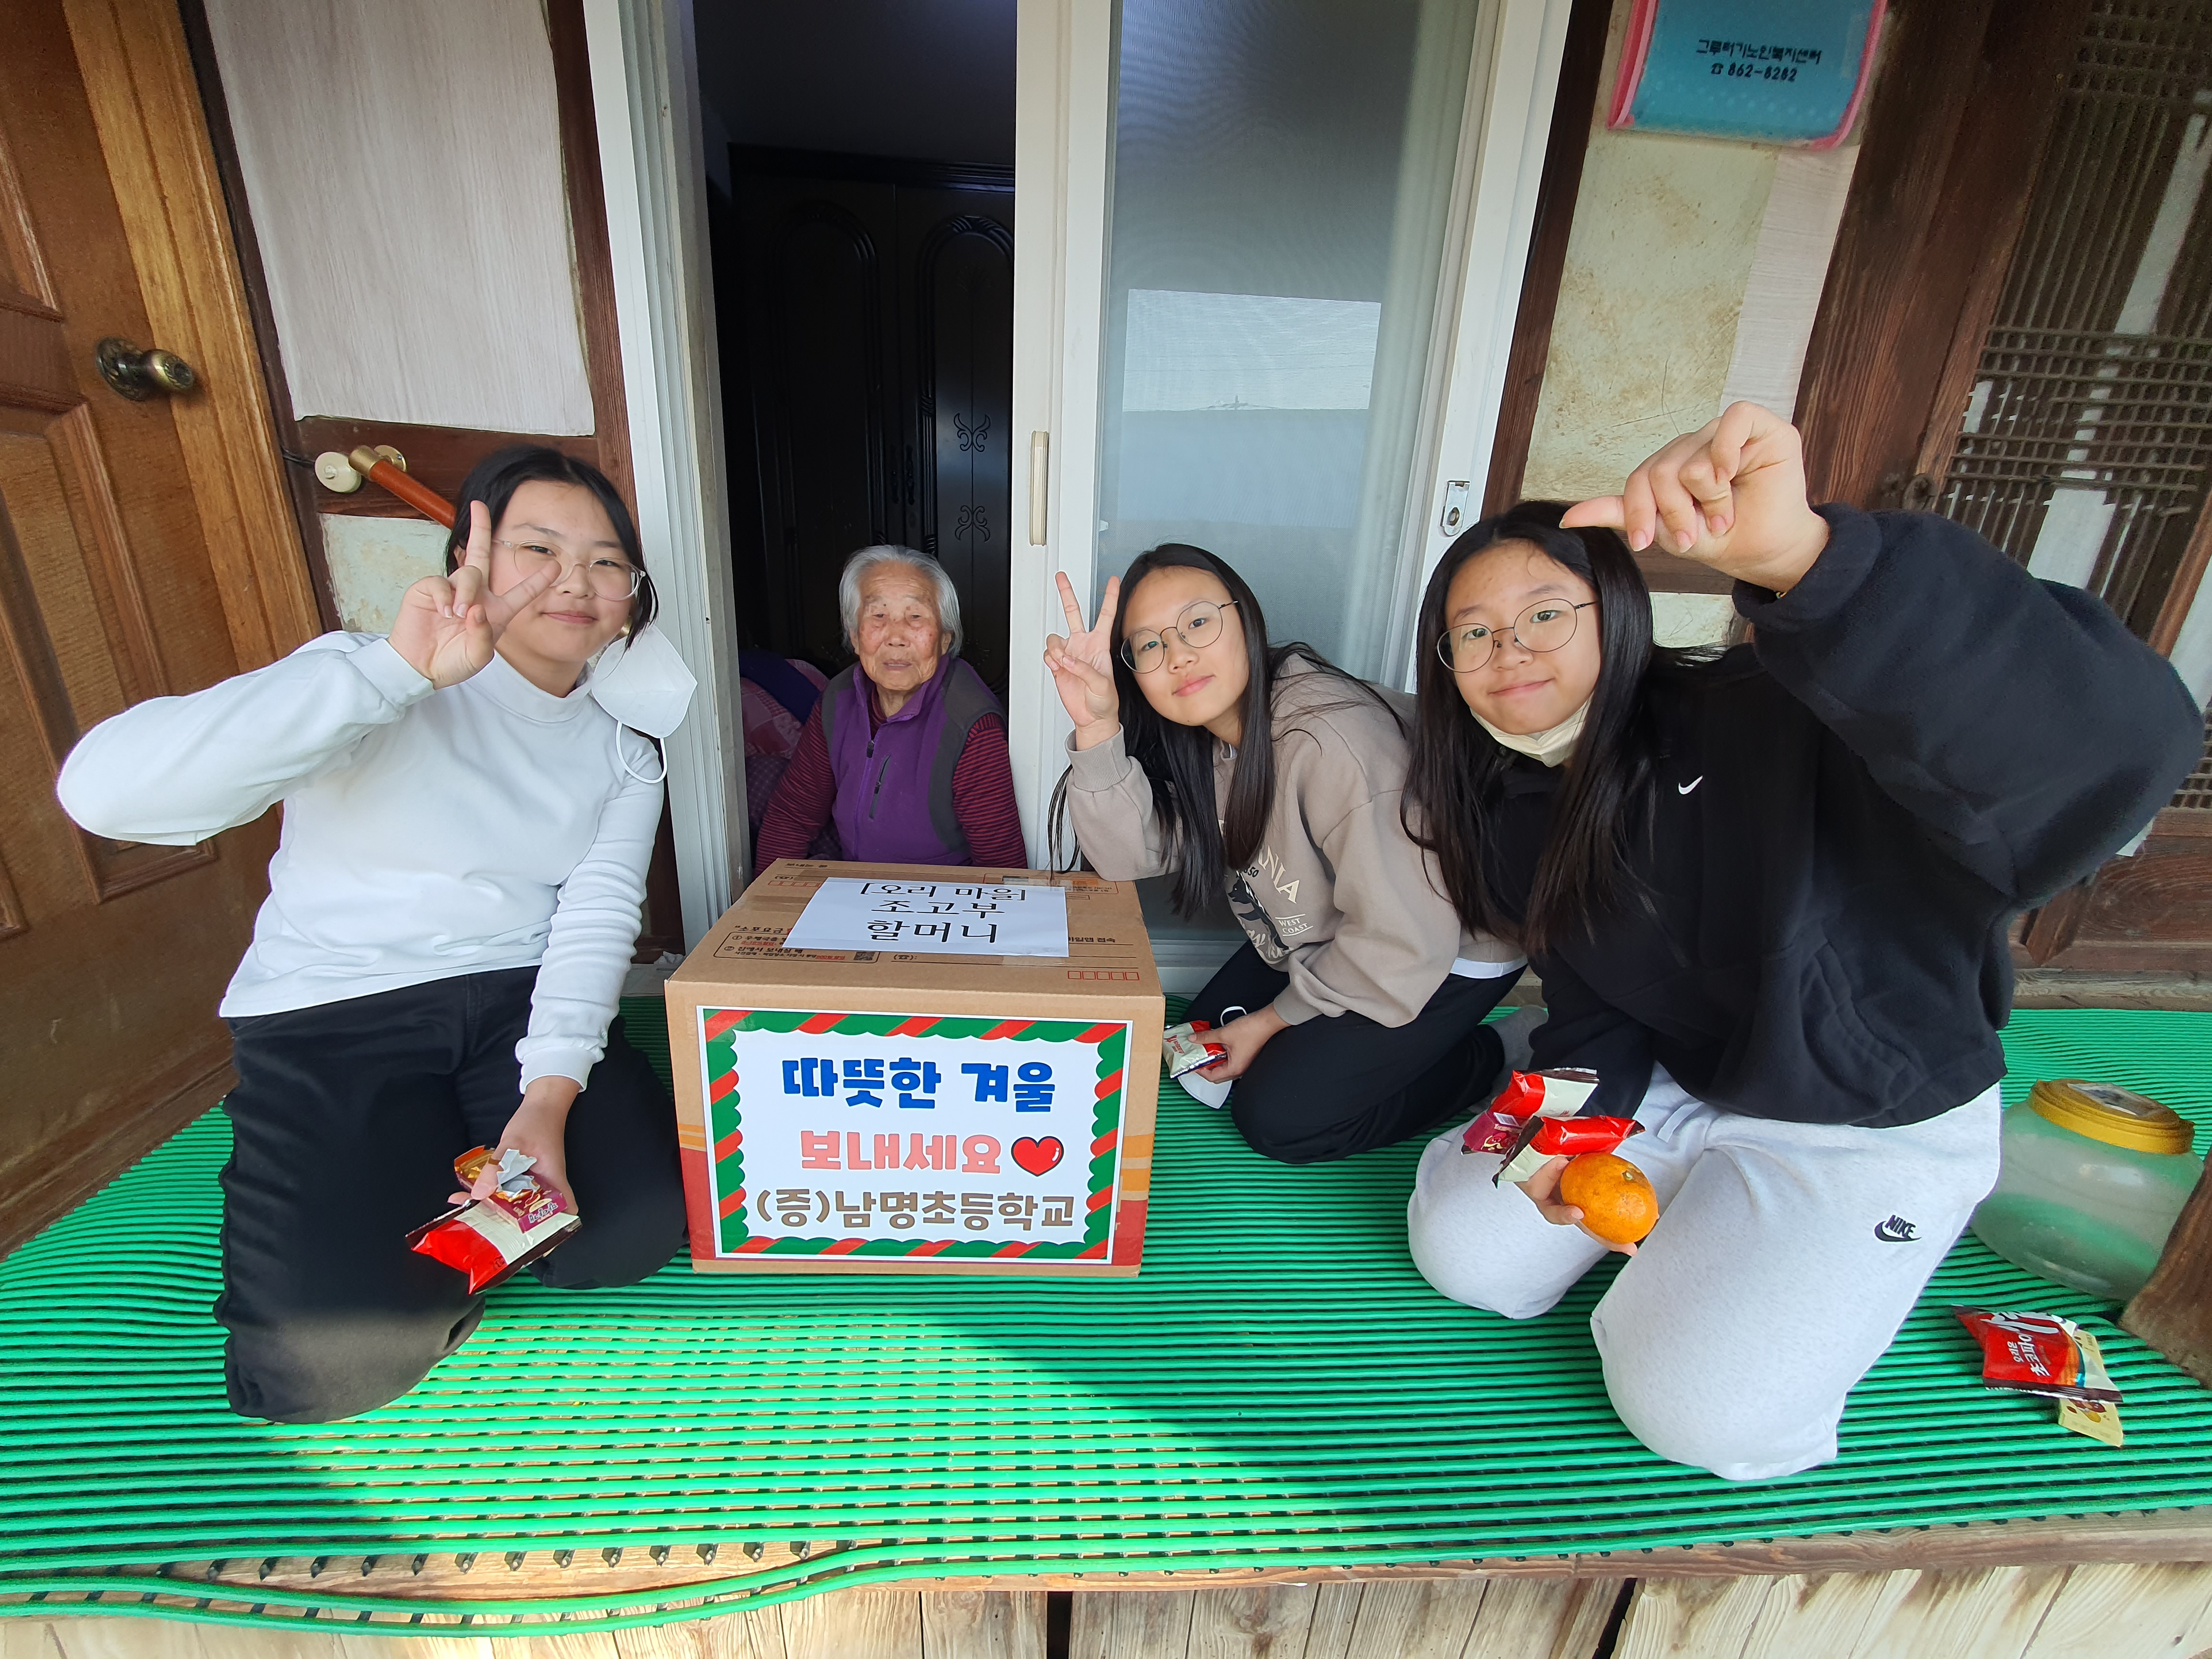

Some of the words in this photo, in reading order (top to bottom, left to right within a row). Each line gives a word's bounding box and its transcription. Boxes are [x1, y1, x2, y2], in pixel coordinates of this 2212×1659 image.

[860, 883, 937, 898] [오리
[955, 887, 1026, 901] 마을]
[871, 900, 1005, 919] 조고부
[866, 920, 998, 943] 할머니
[1278, 918, 1301, 927] WEST
[1282, 923, 1309, 934] COAST
[782, 1058, 941, 1109] 따뜻한
[961, 1062, 1056, 1113] 겨울
[801, 1130, 1001, 1174] 보내세요
[757, 1188, 1074, 1232] (증)남명초등학교
[1884, 1214, 1916, 1238] NIKE
[2007, 1341, 2024, 1362] 오리온
[2017, 1332, 2051, 1377] 초코파이
